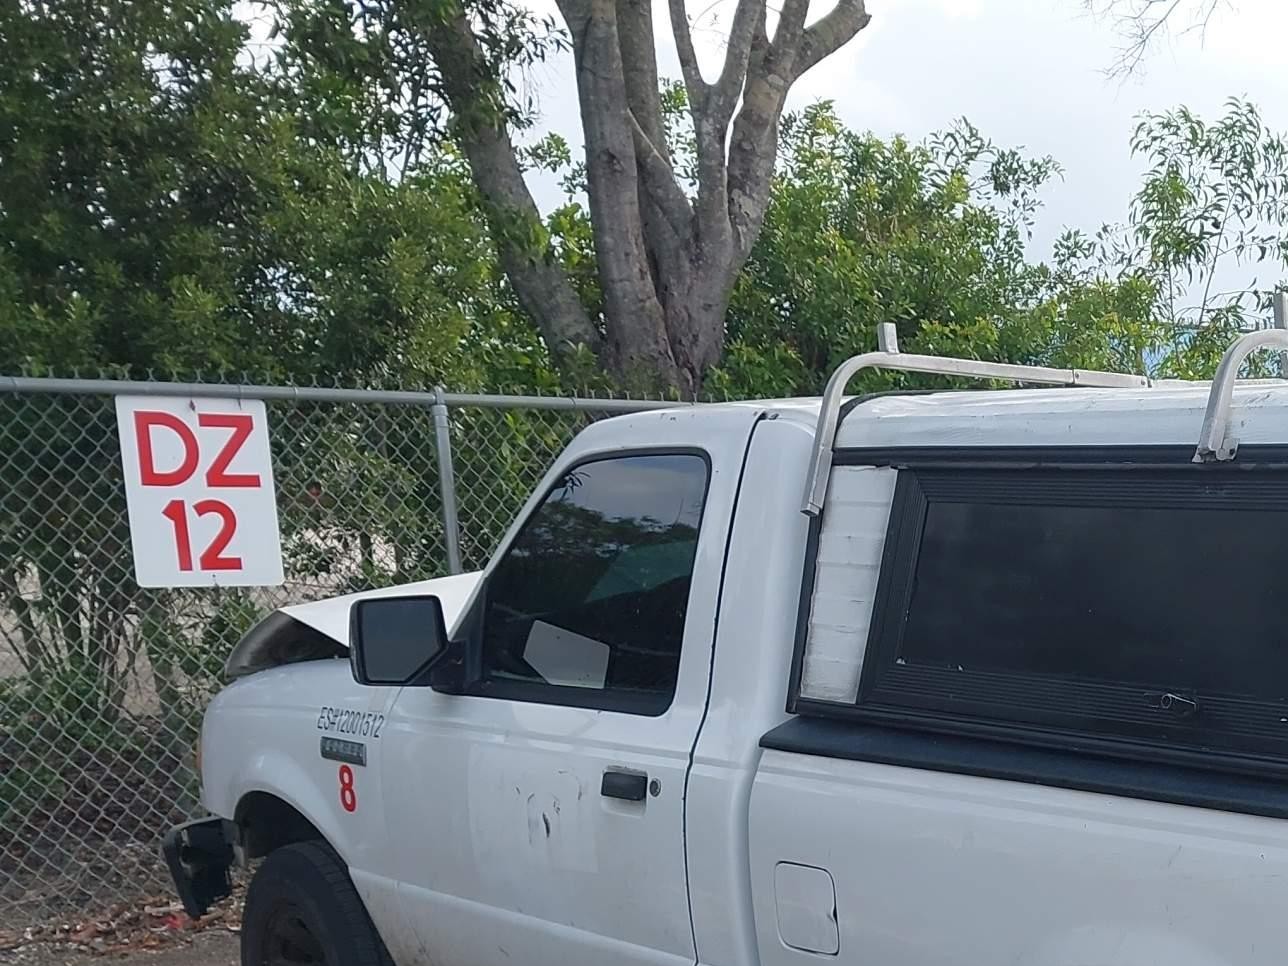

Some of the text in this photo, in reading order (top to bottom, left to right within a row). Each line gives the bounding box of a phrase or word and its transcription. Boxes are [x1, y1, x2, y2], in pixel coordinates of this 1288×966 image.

[133, 411, 261, 488] DZ
[162, 499, 243, 571] 12
[317, 706, 385, 738] ES#12001512
[339, 764, 356, 812] 8
